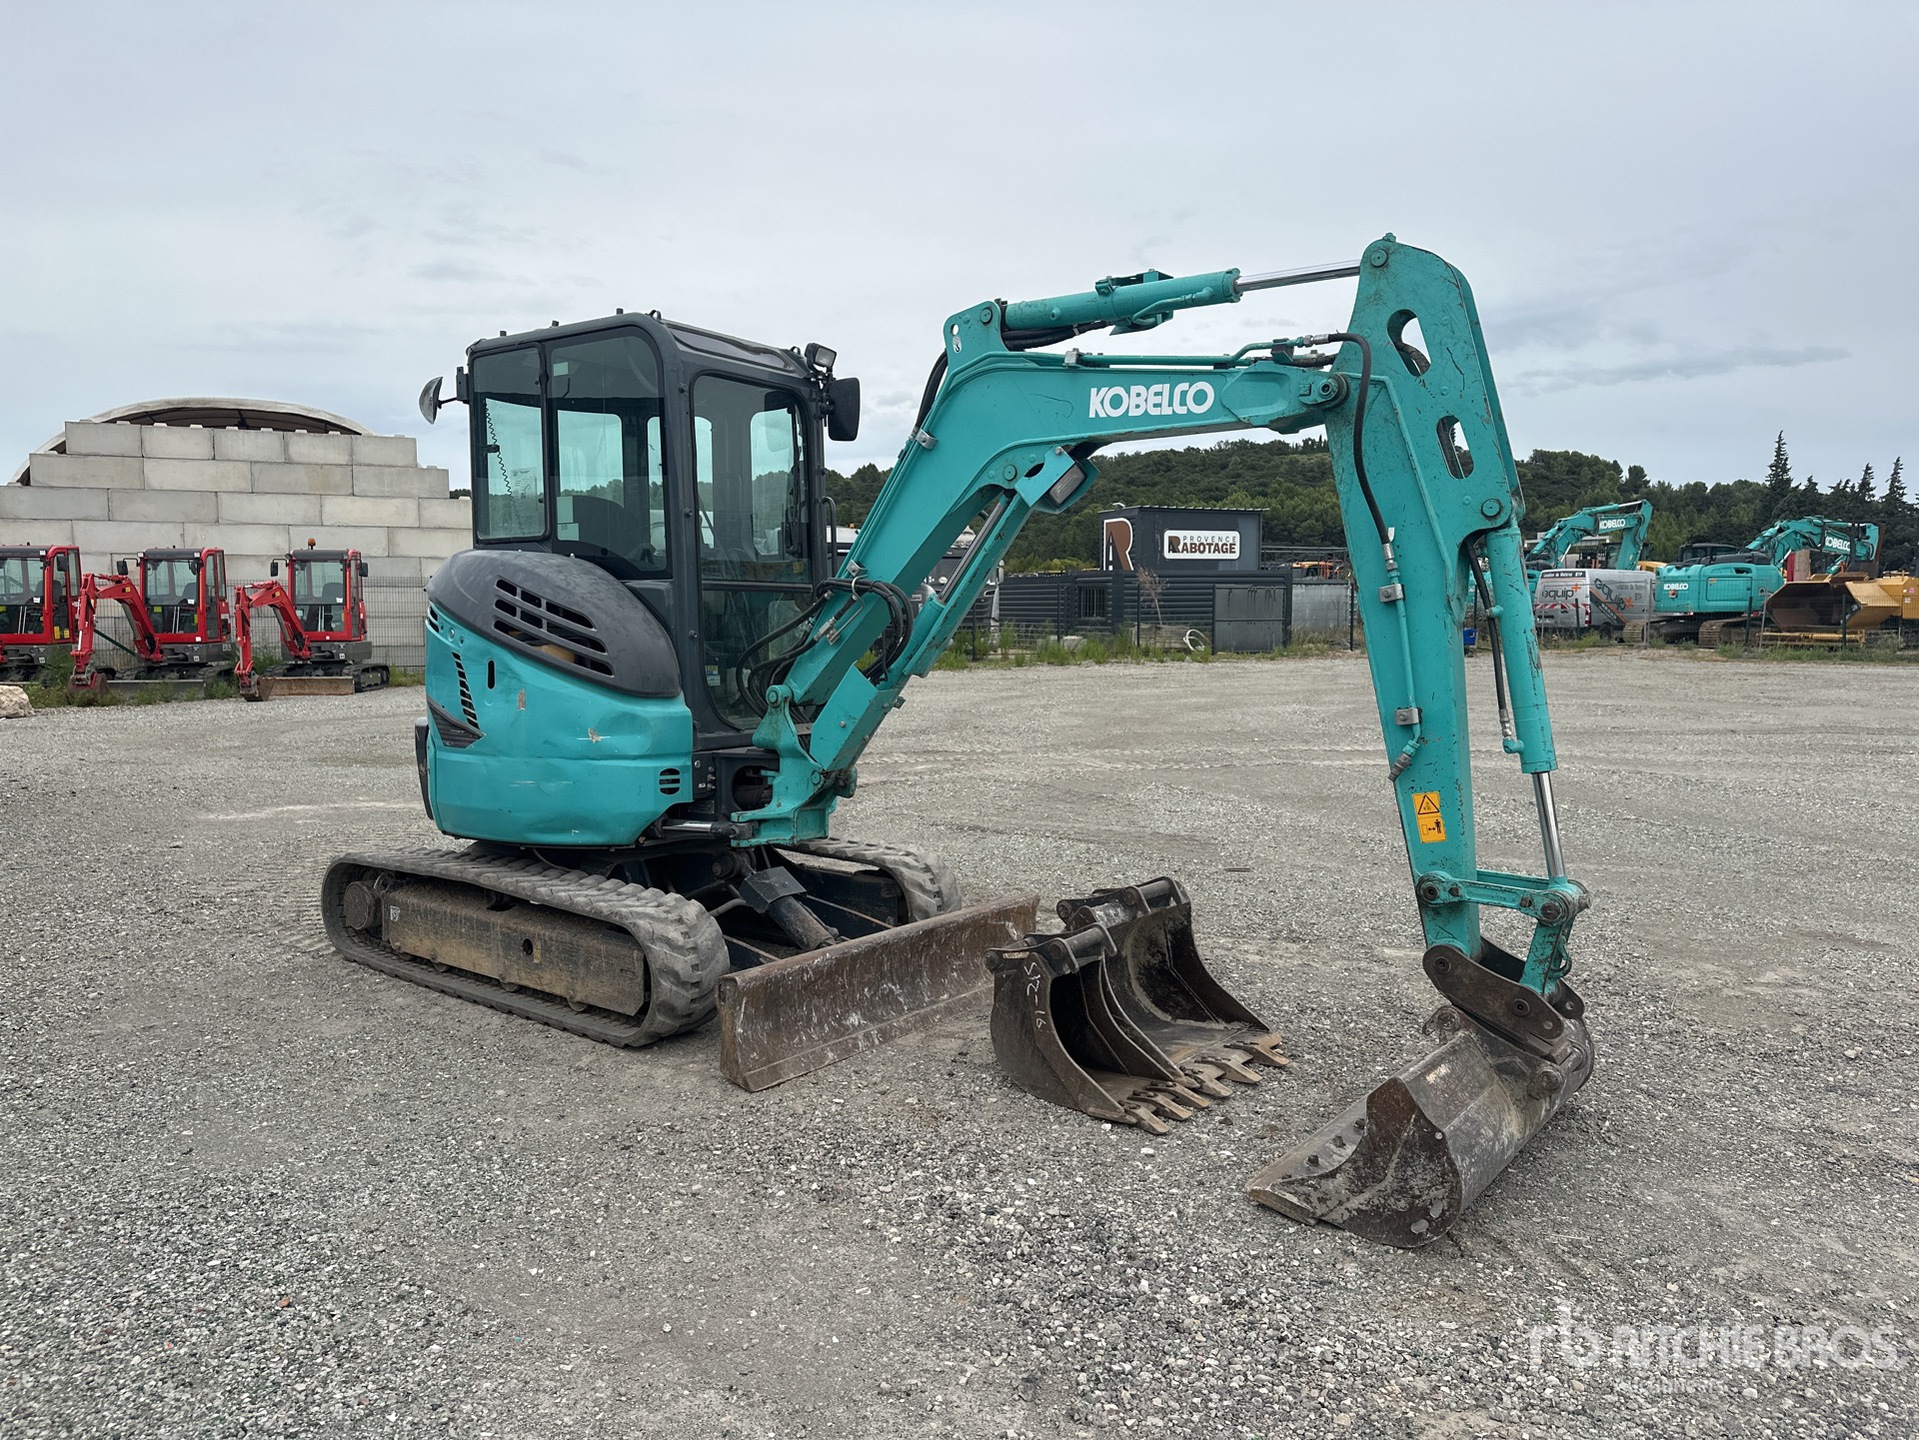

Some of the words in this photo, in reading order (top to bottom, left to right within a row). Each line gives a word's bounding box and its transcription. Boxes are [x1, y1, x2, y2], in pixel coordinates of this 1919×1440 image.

[1089, 381, 1215, 418] KOBELCO
[1599, 519, 1626, 530] KOBELCO
[1663, 583, 1689, 591] KOBELCO
